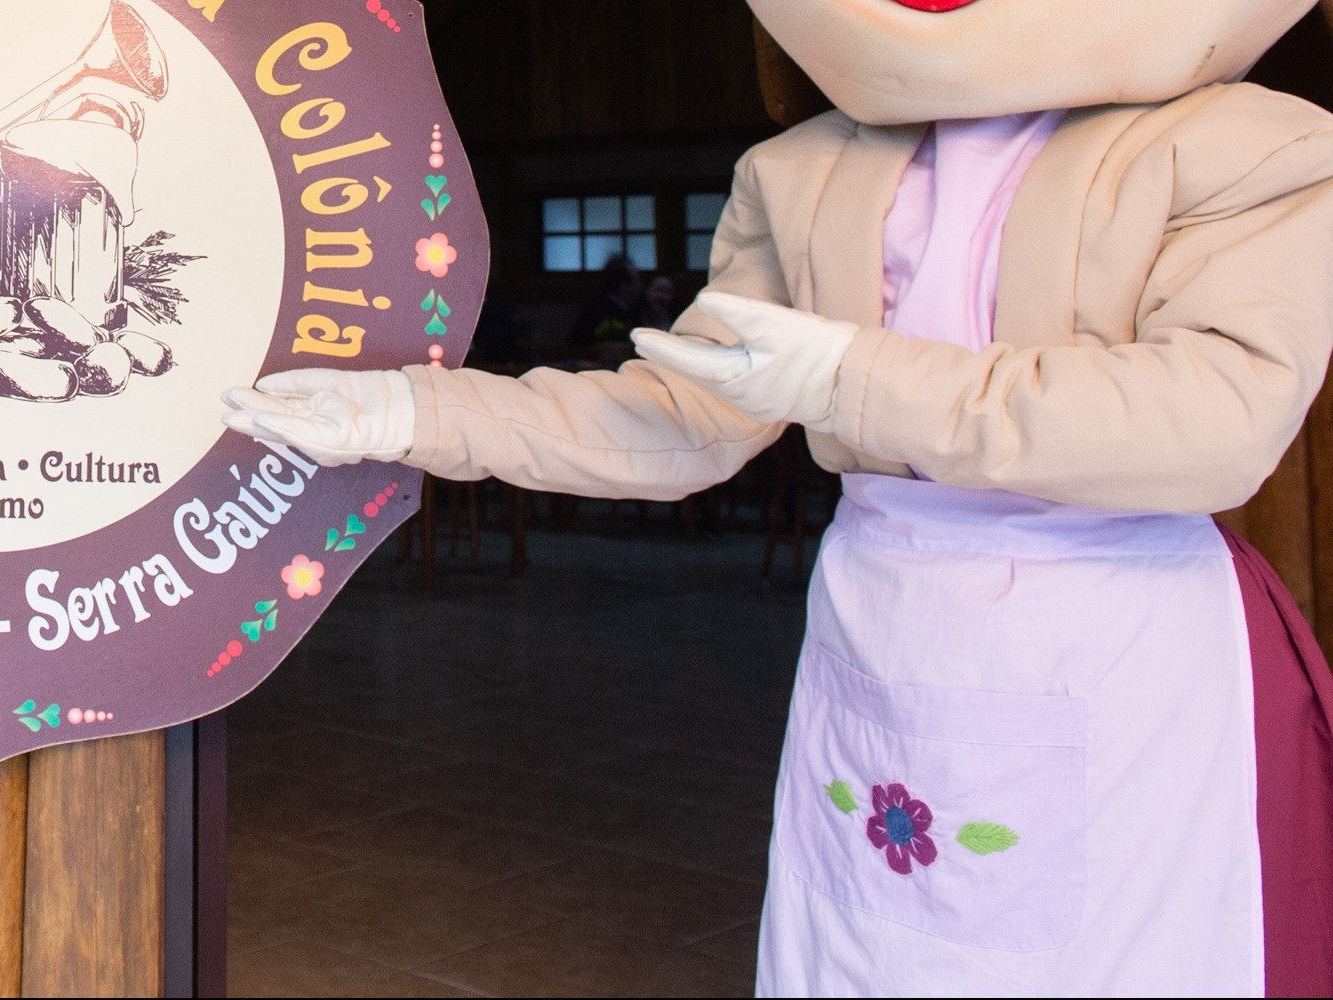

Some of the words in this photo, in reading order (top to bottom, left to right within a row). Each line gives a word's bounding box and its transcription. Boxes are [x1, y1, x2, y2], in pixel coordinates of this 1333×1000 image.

[255, 22, 392, 358] Colônia
[40, 450, 162, 484] Cultura
[25, 553, 194, 651] Serra
